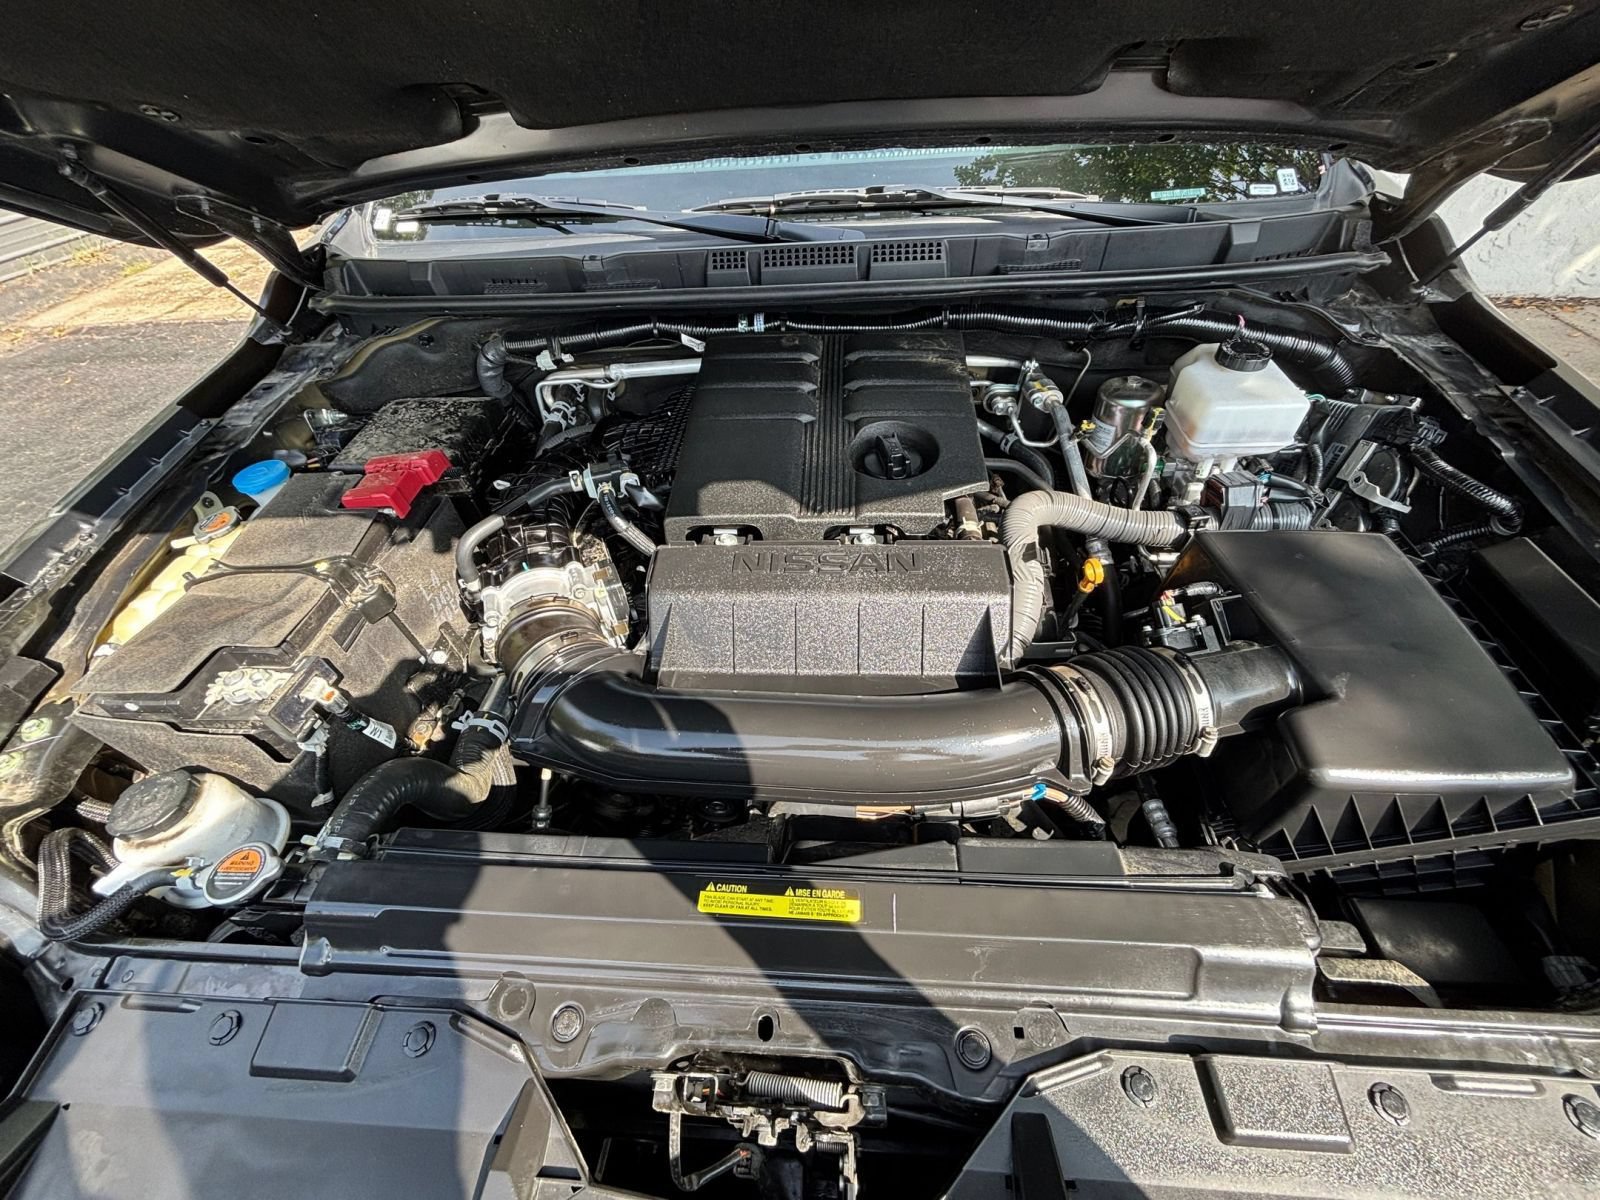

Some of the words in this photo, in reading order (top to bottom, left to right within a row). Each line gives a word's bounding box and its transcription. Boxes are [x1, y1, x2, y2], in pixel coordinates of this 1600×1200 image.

[732, 552, 923, 573] NISSAN
[716, 884, 747, 893] CAUTION
[812, 889, 820, 897] EN
[822, 890, 845, 899] GARDE
